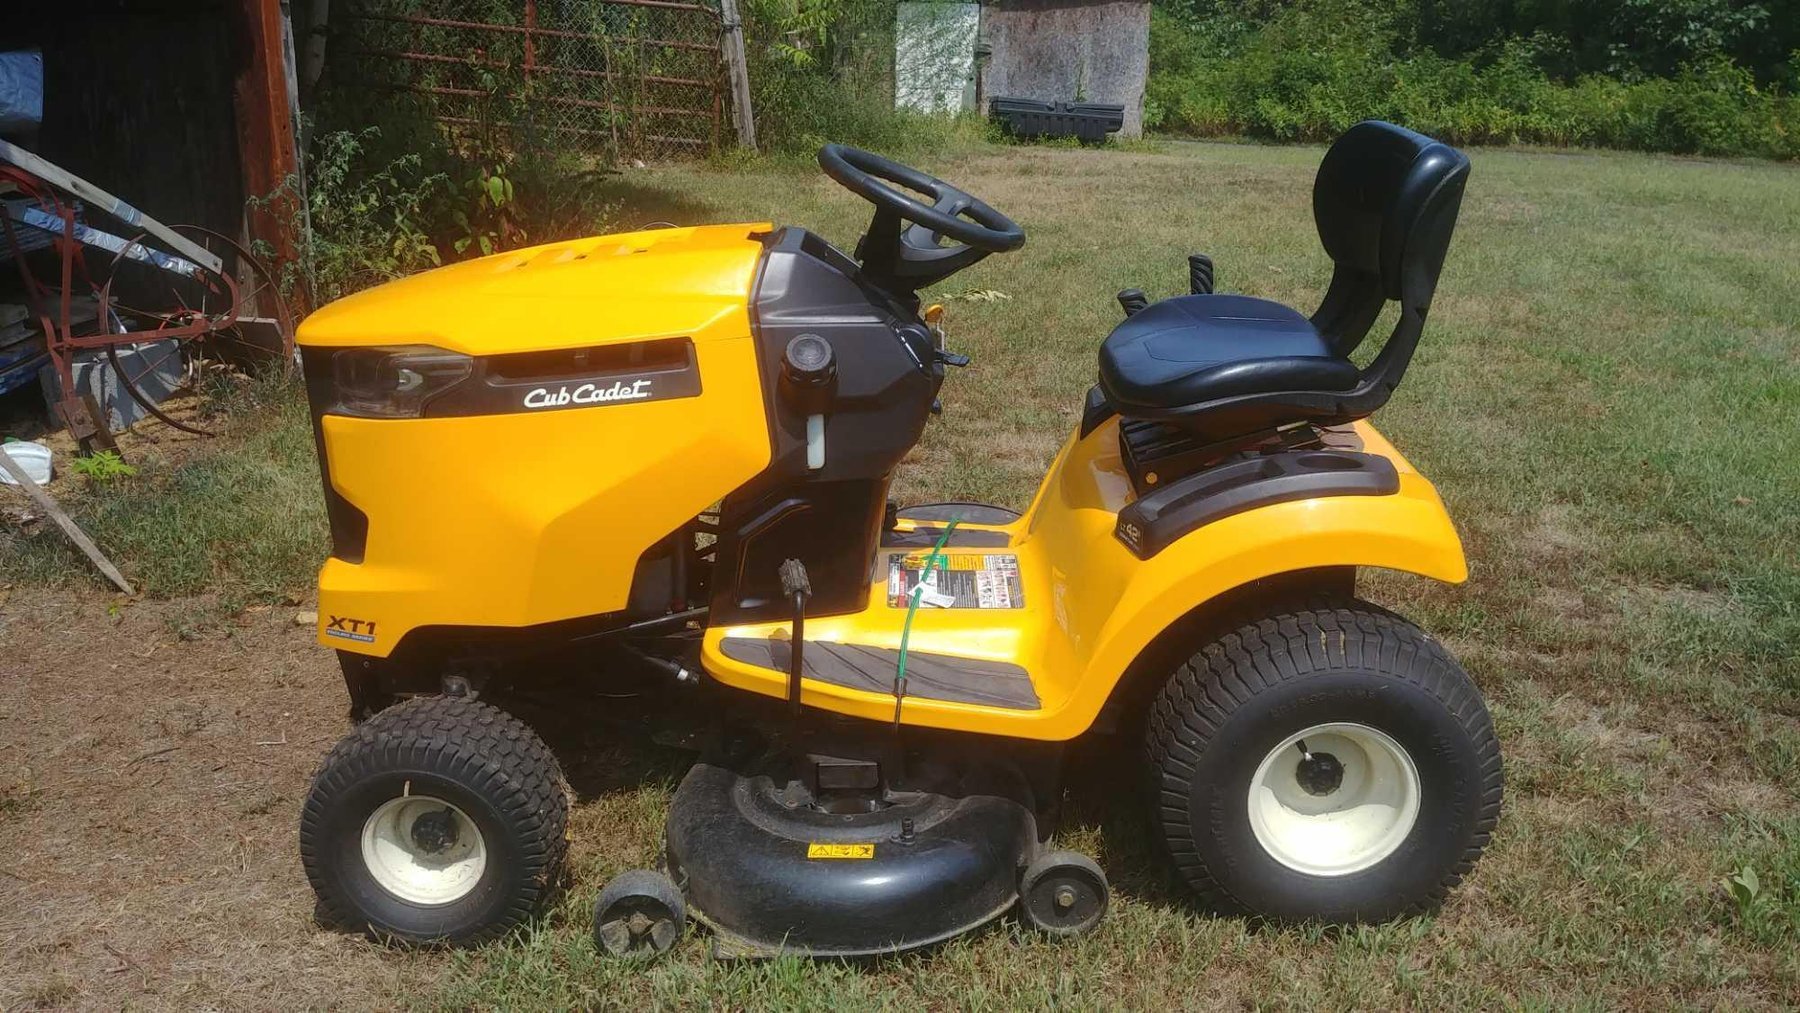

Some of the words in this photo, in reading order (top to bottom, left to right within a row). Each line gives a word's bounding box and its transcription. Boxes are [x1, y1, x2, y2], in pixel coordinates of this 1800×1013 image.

[524, 386, 571, 408] Cub
[572, 380, 651, 403] Cadet
[327, 615, 376, 635] XT1
